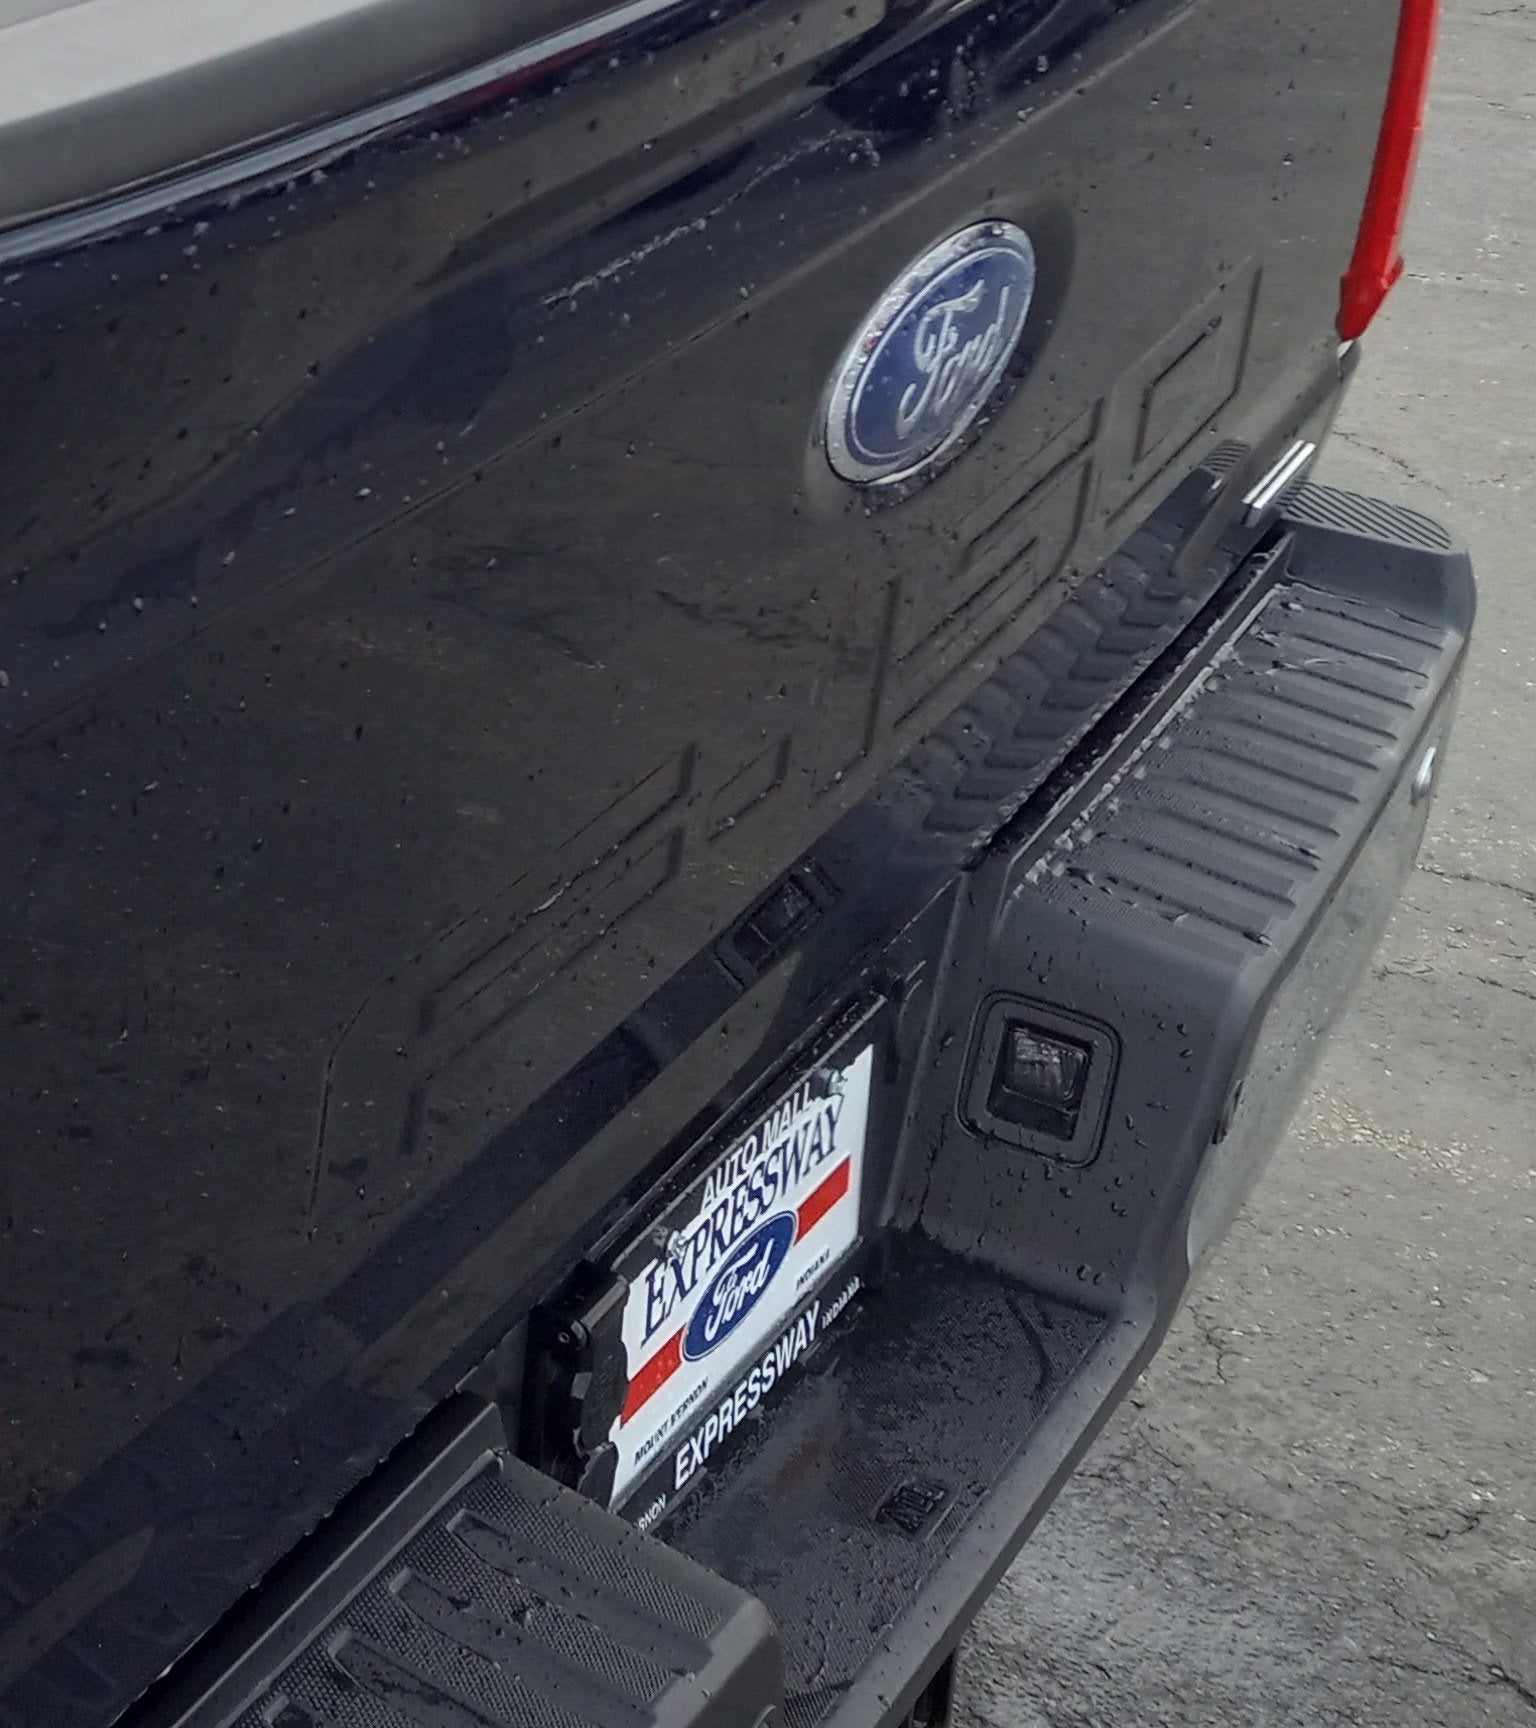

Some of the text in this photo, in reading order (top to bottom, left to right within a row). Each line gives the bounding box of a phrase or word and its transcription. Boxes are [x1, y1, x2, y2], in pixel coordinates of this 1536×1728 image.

[894, 278, 1012, 441] Ford
[640, 1092, 845, 1349] EXPRESSWAY
[699, 1081, 813, 1215] AUTO MALL
[704, 1236, 776, 1342] Ford
[675, 1299, 821, 1490] EXPRESSWAY
